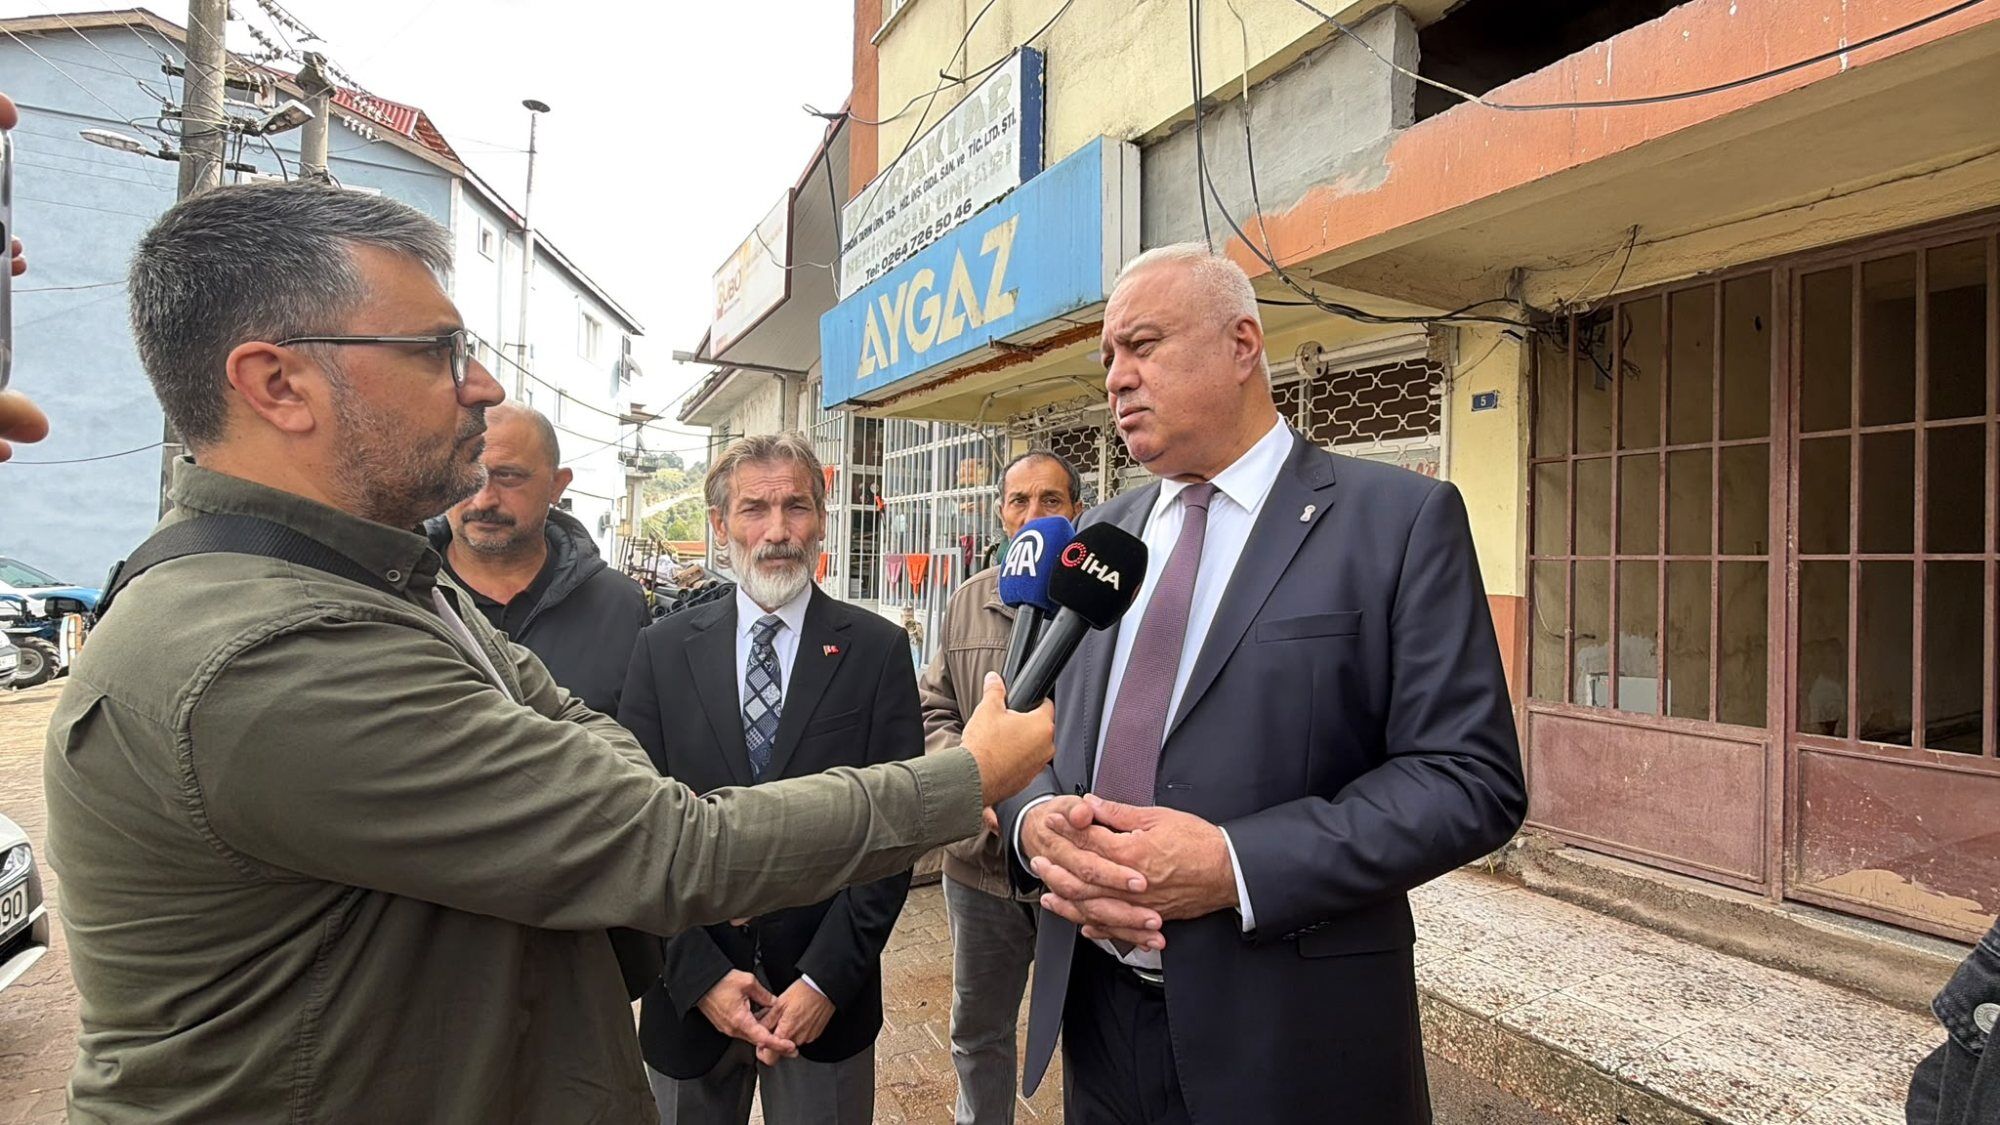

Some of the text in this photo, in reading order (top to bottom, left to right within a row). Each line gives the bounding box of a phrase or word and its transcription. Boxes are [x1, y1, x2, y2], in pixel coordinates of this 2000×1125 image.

[957, 153, 966, 168] ve
[968, 138, 984, 158] TİC.
[984, 124, 1000, 147] LTD.
[1001, 106, 1017, 135] ŞTİ.
[865, 263, 880, 281] Tel:
[881, 241, 908, 270] 0264
[910, 224, 933, 251] 726
[935, 212, 952, 234] 50
[953, 198, 972, 220] 46
[856, 212, 1020, 380] AYGAZ
[1480, 396, 1487, 406] 5
[1002, 540, 1037, 577] AA
[1080, 552, 1120, 591] İHA
